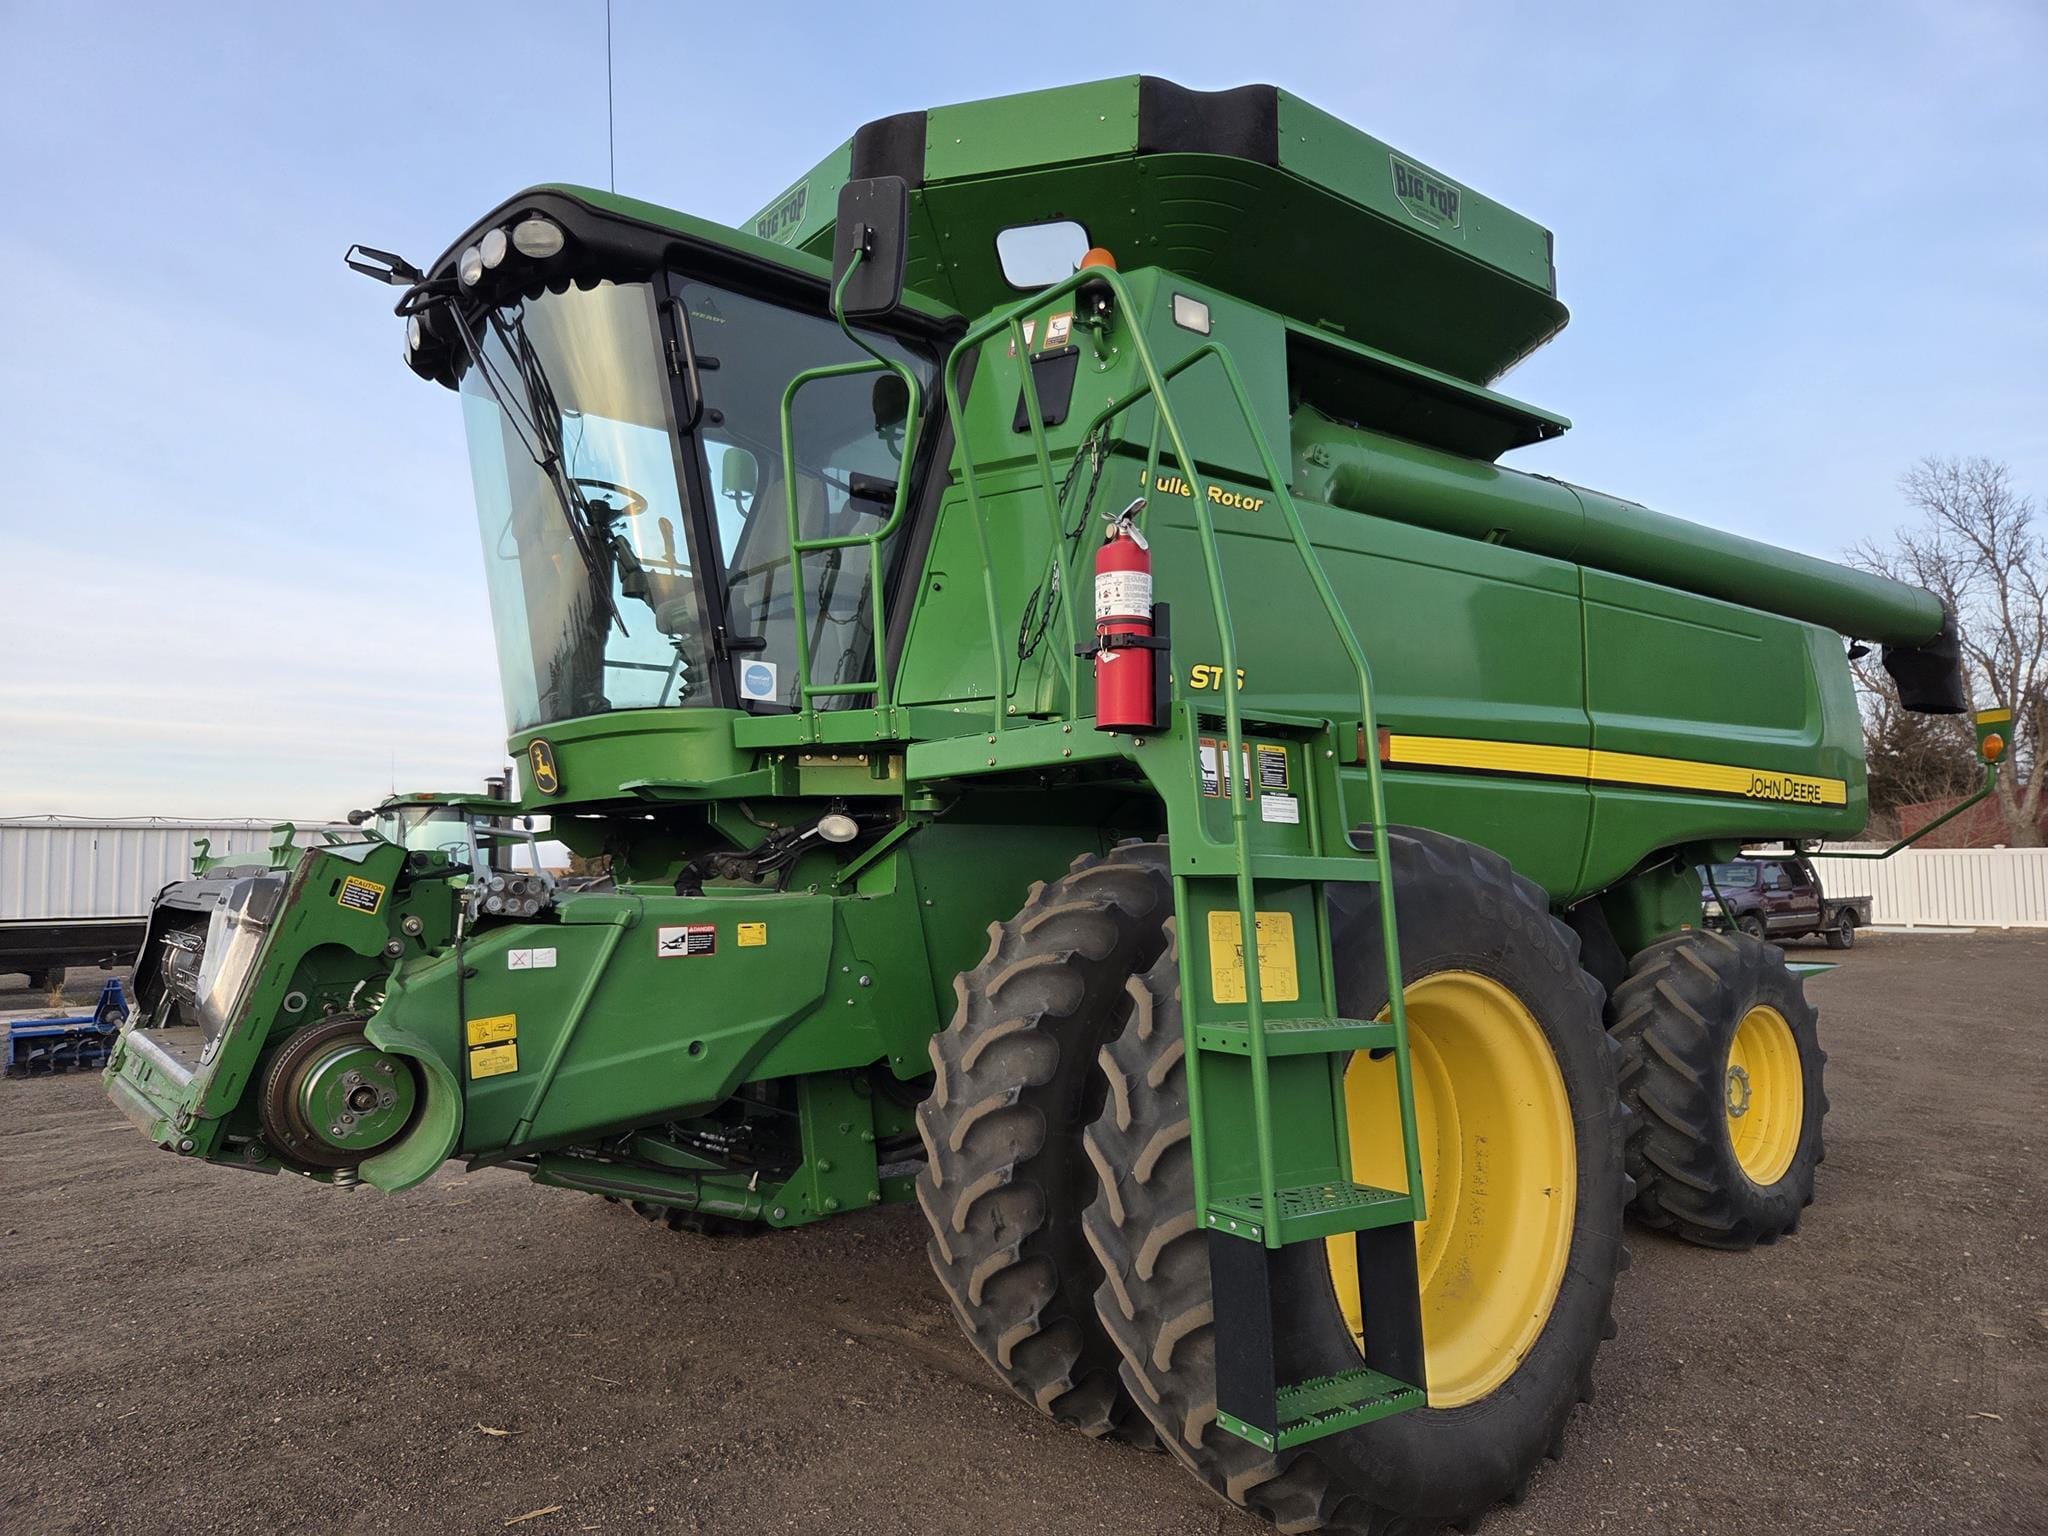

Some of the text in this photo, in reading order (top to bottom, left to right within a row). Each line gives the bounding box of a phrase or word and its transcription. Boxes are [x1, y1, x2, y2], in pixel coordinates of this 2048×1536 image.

[1394, 162, 1424, 202] BIG
[1426, 183, 1458, 221] TOP
[780, 187, 806, 228] TOP
[1207, 485, 1264, 512] Rotor
[1746, 773, 1822, 802] JOHN DEERE
[354, 879, 384, 892] CAUTION
